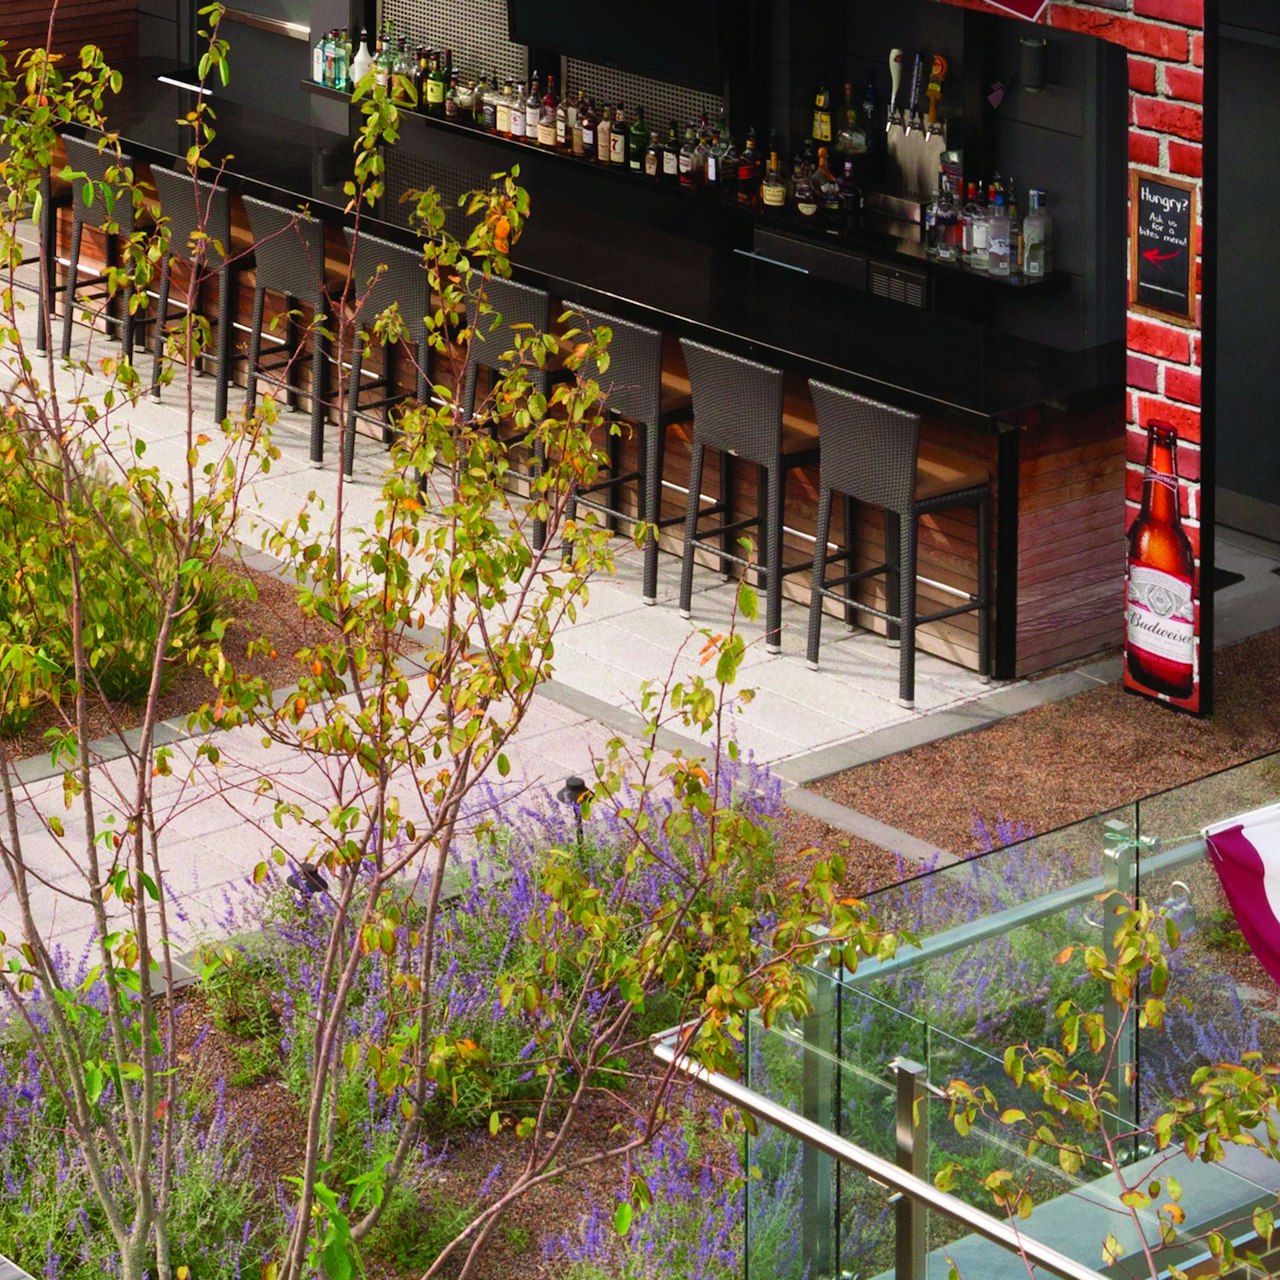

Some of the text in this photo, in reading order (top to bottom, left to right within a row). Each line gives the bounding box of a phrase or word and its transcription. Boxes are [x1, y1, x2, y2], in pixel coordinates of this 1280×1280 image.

[1141, 187, 1189, 212] Hungry?
[1149, 212, 1163, 224] Ask
[1152, 222, 1164, 232] for
[1139, 226, 1187, 246] bites menu!
[1130, 612, 1193, 644] Budweiser
